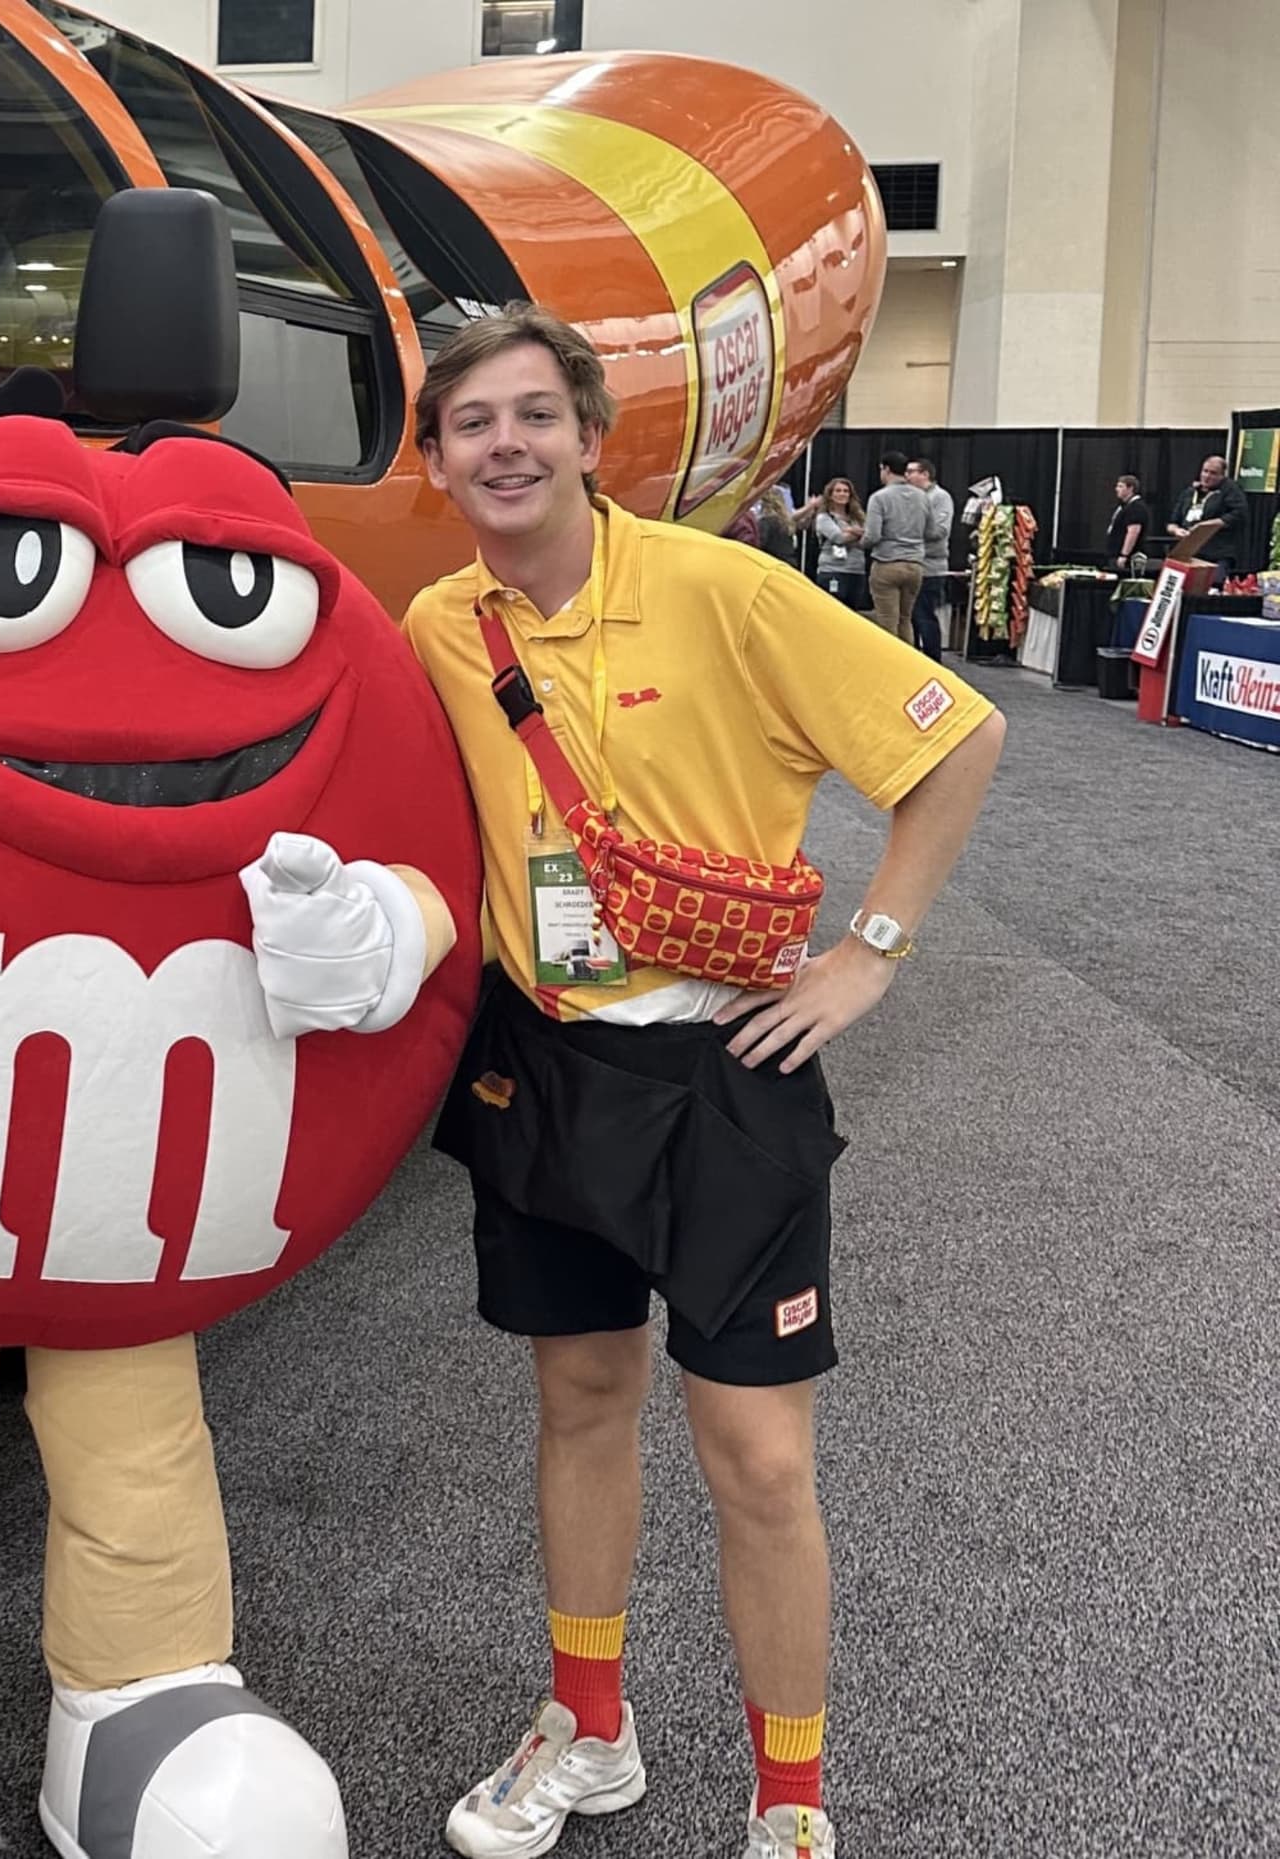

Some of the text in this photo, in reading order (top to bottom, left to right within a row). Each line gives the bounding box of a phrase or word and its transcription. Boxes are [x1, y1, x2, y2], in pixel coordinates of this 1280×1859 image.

[714, 312, 760, 393] Oscar
[705, 367, 765, 456] Mayer
[912, 685, 937, 713] Oscar
[918, 693, 945, 723] Mayer
[783, 1296, 812, 1317] Oscar
[783, 1306, 814, 1328] Mayer
